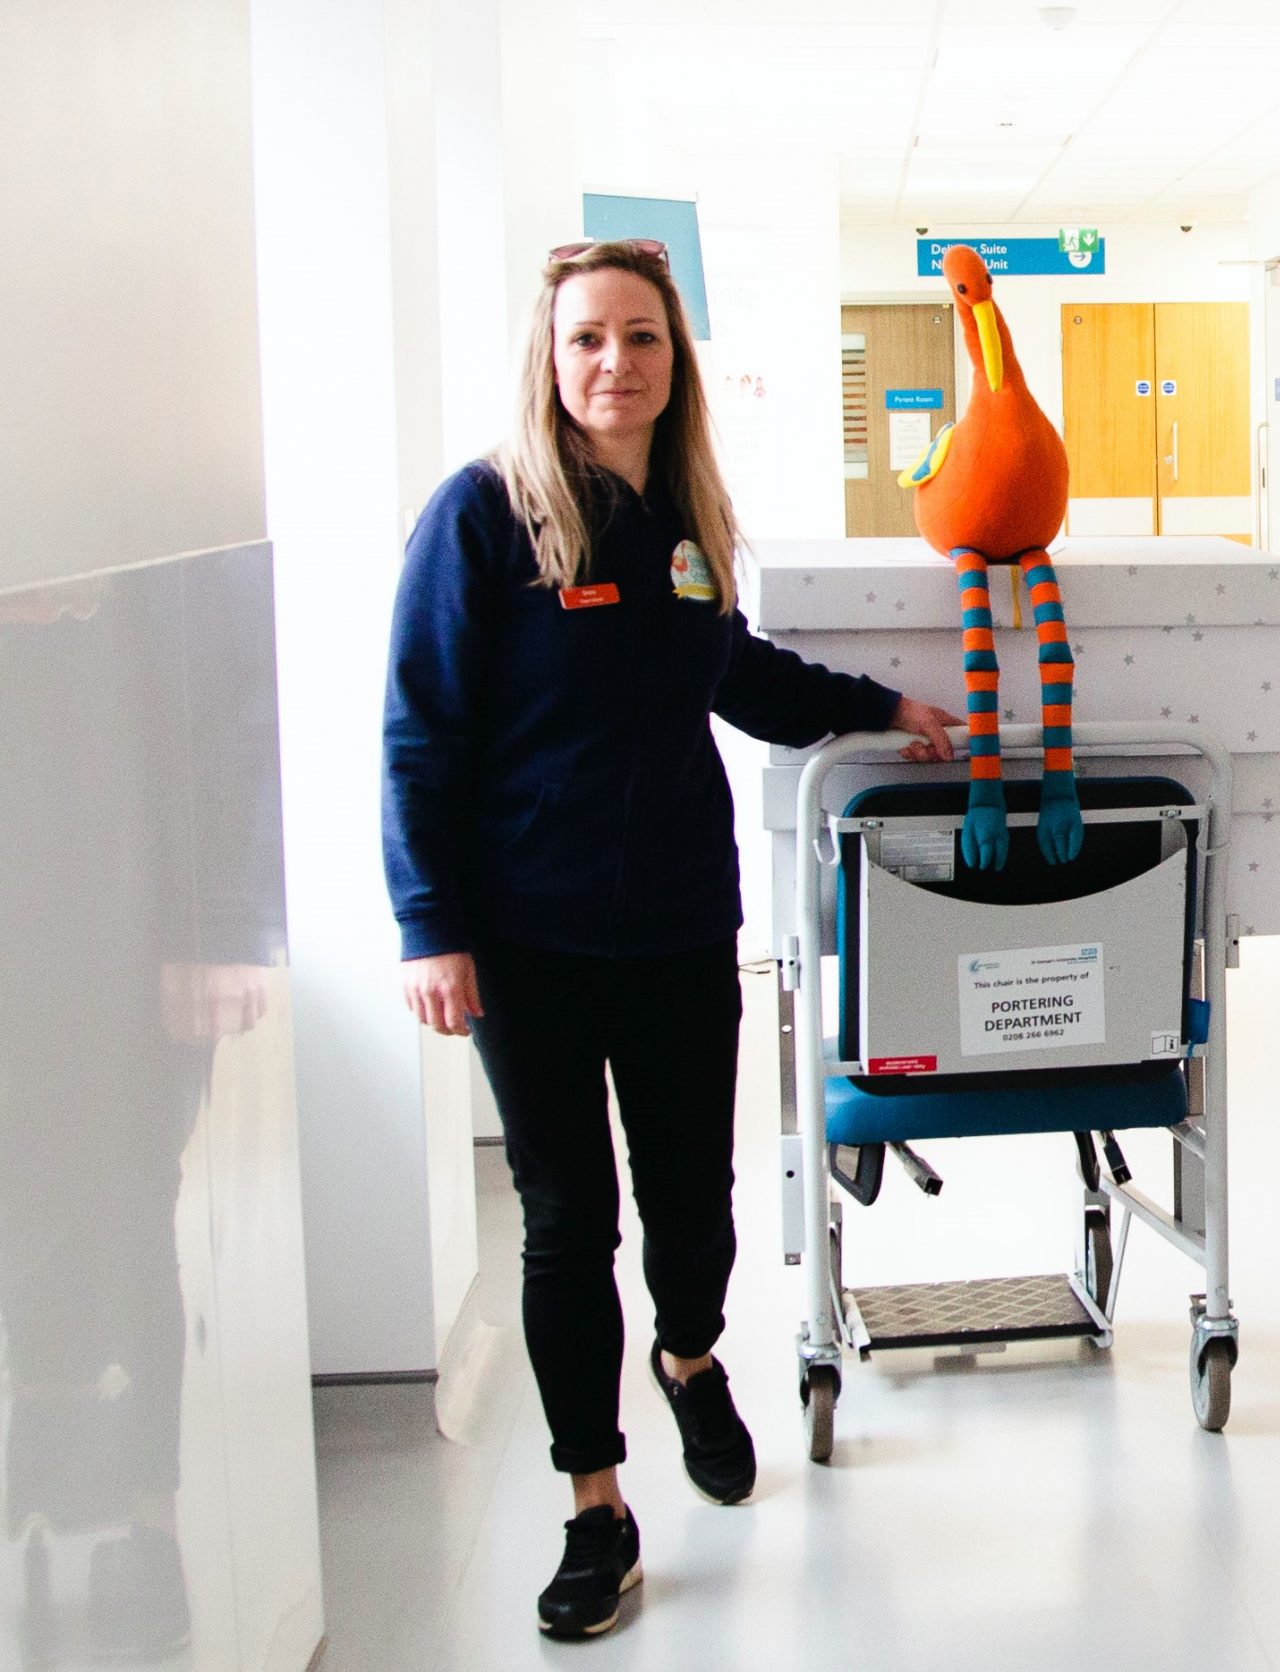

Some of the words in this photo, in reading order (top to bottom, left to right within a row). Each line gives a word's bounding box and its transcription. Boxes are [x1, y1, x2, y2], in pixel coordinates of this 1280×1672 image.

[980, 244, 1007, 254] Suite
[985, 259, 1008, 269] Unit
[974, 981, 991, 989] This
[993, 980, 1013, 988] chair
[1025, 976, 1039, 984] the
[1041, 974, 1077, 984] property
[1080, 971, 1089, 980] of
[991, 995, 1074, 1013] PORTERING
[984, 1011, 1082, 1031] DEPARTMENT
[1003, 1032, 1023, 1041] 0208
[1026, 1031, 1042, 1039] 266
[1044, 1029, 1064, 1037] 6962
